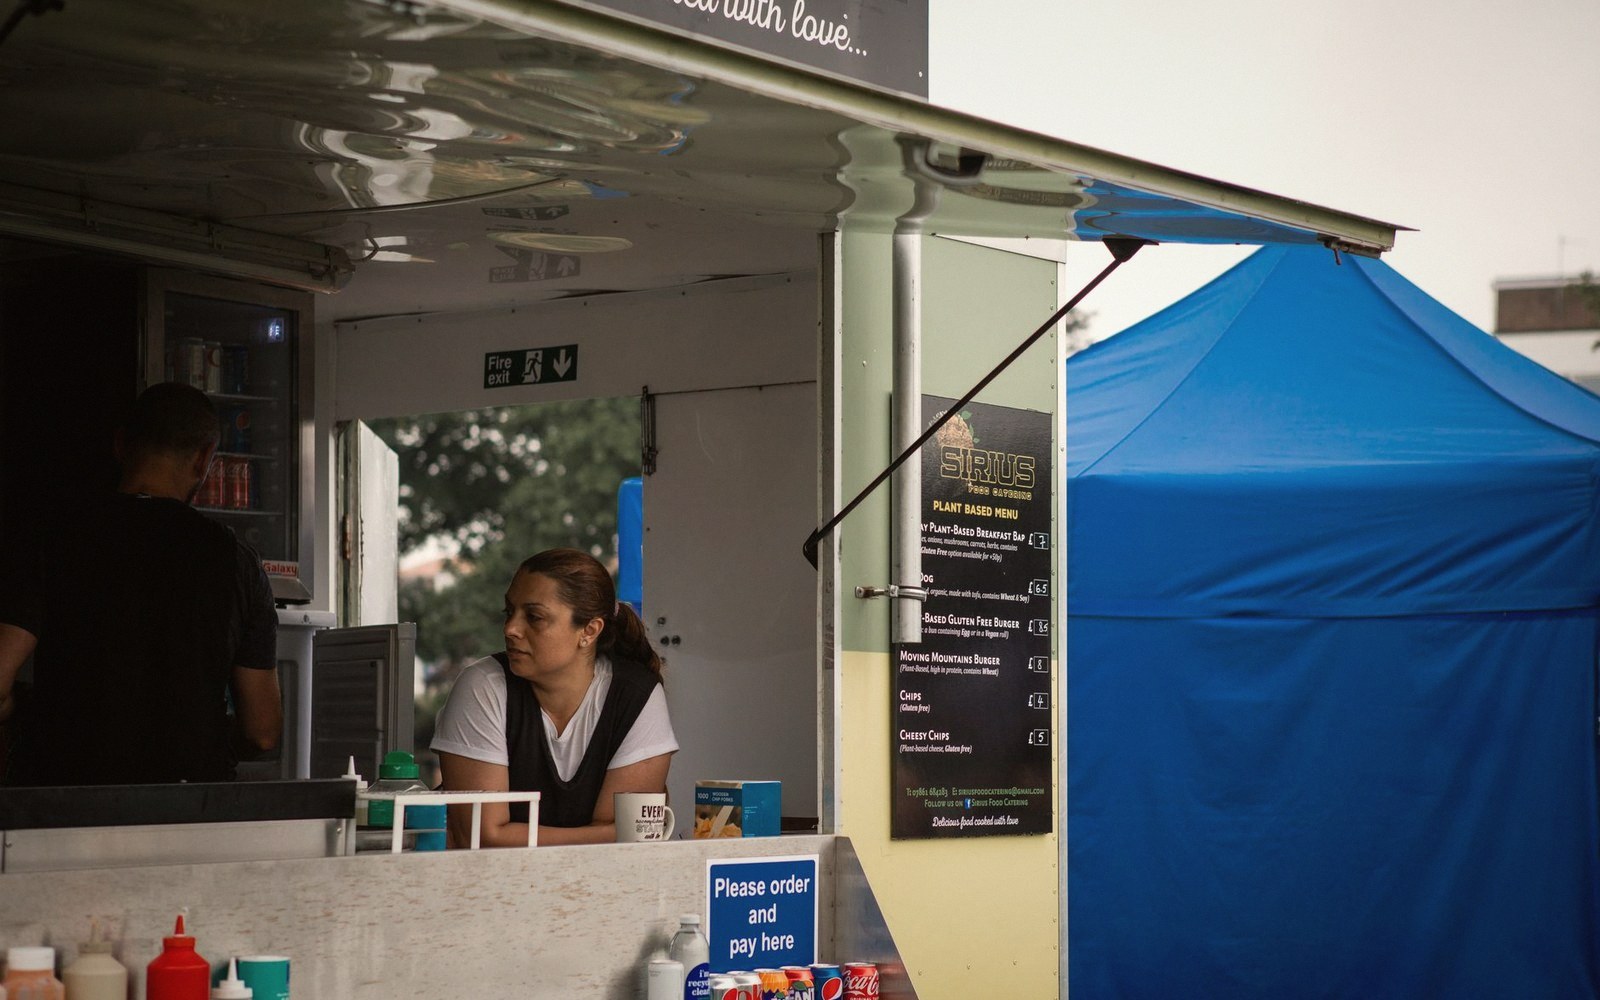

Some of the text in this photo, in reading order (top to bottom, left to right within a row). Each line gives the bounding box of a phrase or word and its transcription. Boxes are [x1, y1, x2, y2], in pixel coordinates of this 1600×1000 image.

[488, 355, 512, 370] Fire
[488, 371, 510, 385] exit
[940, 445, 1035, 489] SIRIUS
[967, 484, 1032, 500] FOOD CATERING
[933, 500, 1018, 520] PLANT BASED MENU
[929, 522, 975, 537] PLANT-BASED
[976, 527, 1012, 541] BREAKFAST
[1012, 531, 1025, 542] BAP
[944, 538, 969, 547] mushrooms,
[970, 541, 986, 549] carrots,
[987, 541, 999, 550] herbs,
[1038, 535, 1046, 549] 7
[937, 547, 947, 556] Free
[948, 550, 962, 558] option
[962, 551, 982, 559] available
[263, 562, 297, 576] Galaxy
[930, 588, 948, 597] organic,
[949, 589, 960, 597] made
[961, 590, 971, 598] with
[1000, 593, 1014, 601] Wheat
[921, 612, 1020, 629] -BASED GLUTEN FREE BURGER
[938, 628, 960, 637] containing
[961, 629, 971, 638] Egg
[985, 630, 999, 639] Vegan
[900, 650, 1000, 666] MOVING MOUNTAINS BURGER
[930, 665, 940, 675] high
[946, 666, 963, 675] protein,
[982, 667, 999, 677] Wheat)
[900, 689, 921, 701] CHIPS
[1037, 695, 1044, 708] 4
[899, 703, 930, 714] (Gluten free)
[899, 729, 950, 741] CHEESY CHIPS
[1038, 732, 1045, 743] 5
[899, 744, 928, 754] (Plant-based
[929, 745, 944, 753] cheese,
[960, 745, 973, 754] free)
[924, 799, 946, 808] FOLLOW
[988, 798, 1003, 806] FOOD
[1004, 798, 1028, 806] CATERING
[932, 815, 1018, 830] Delicious food cooked with love
[715, 874, 810, 898] Please order
[748, 903, 776, 924] and
[729, 932, 794, 959] pay here
